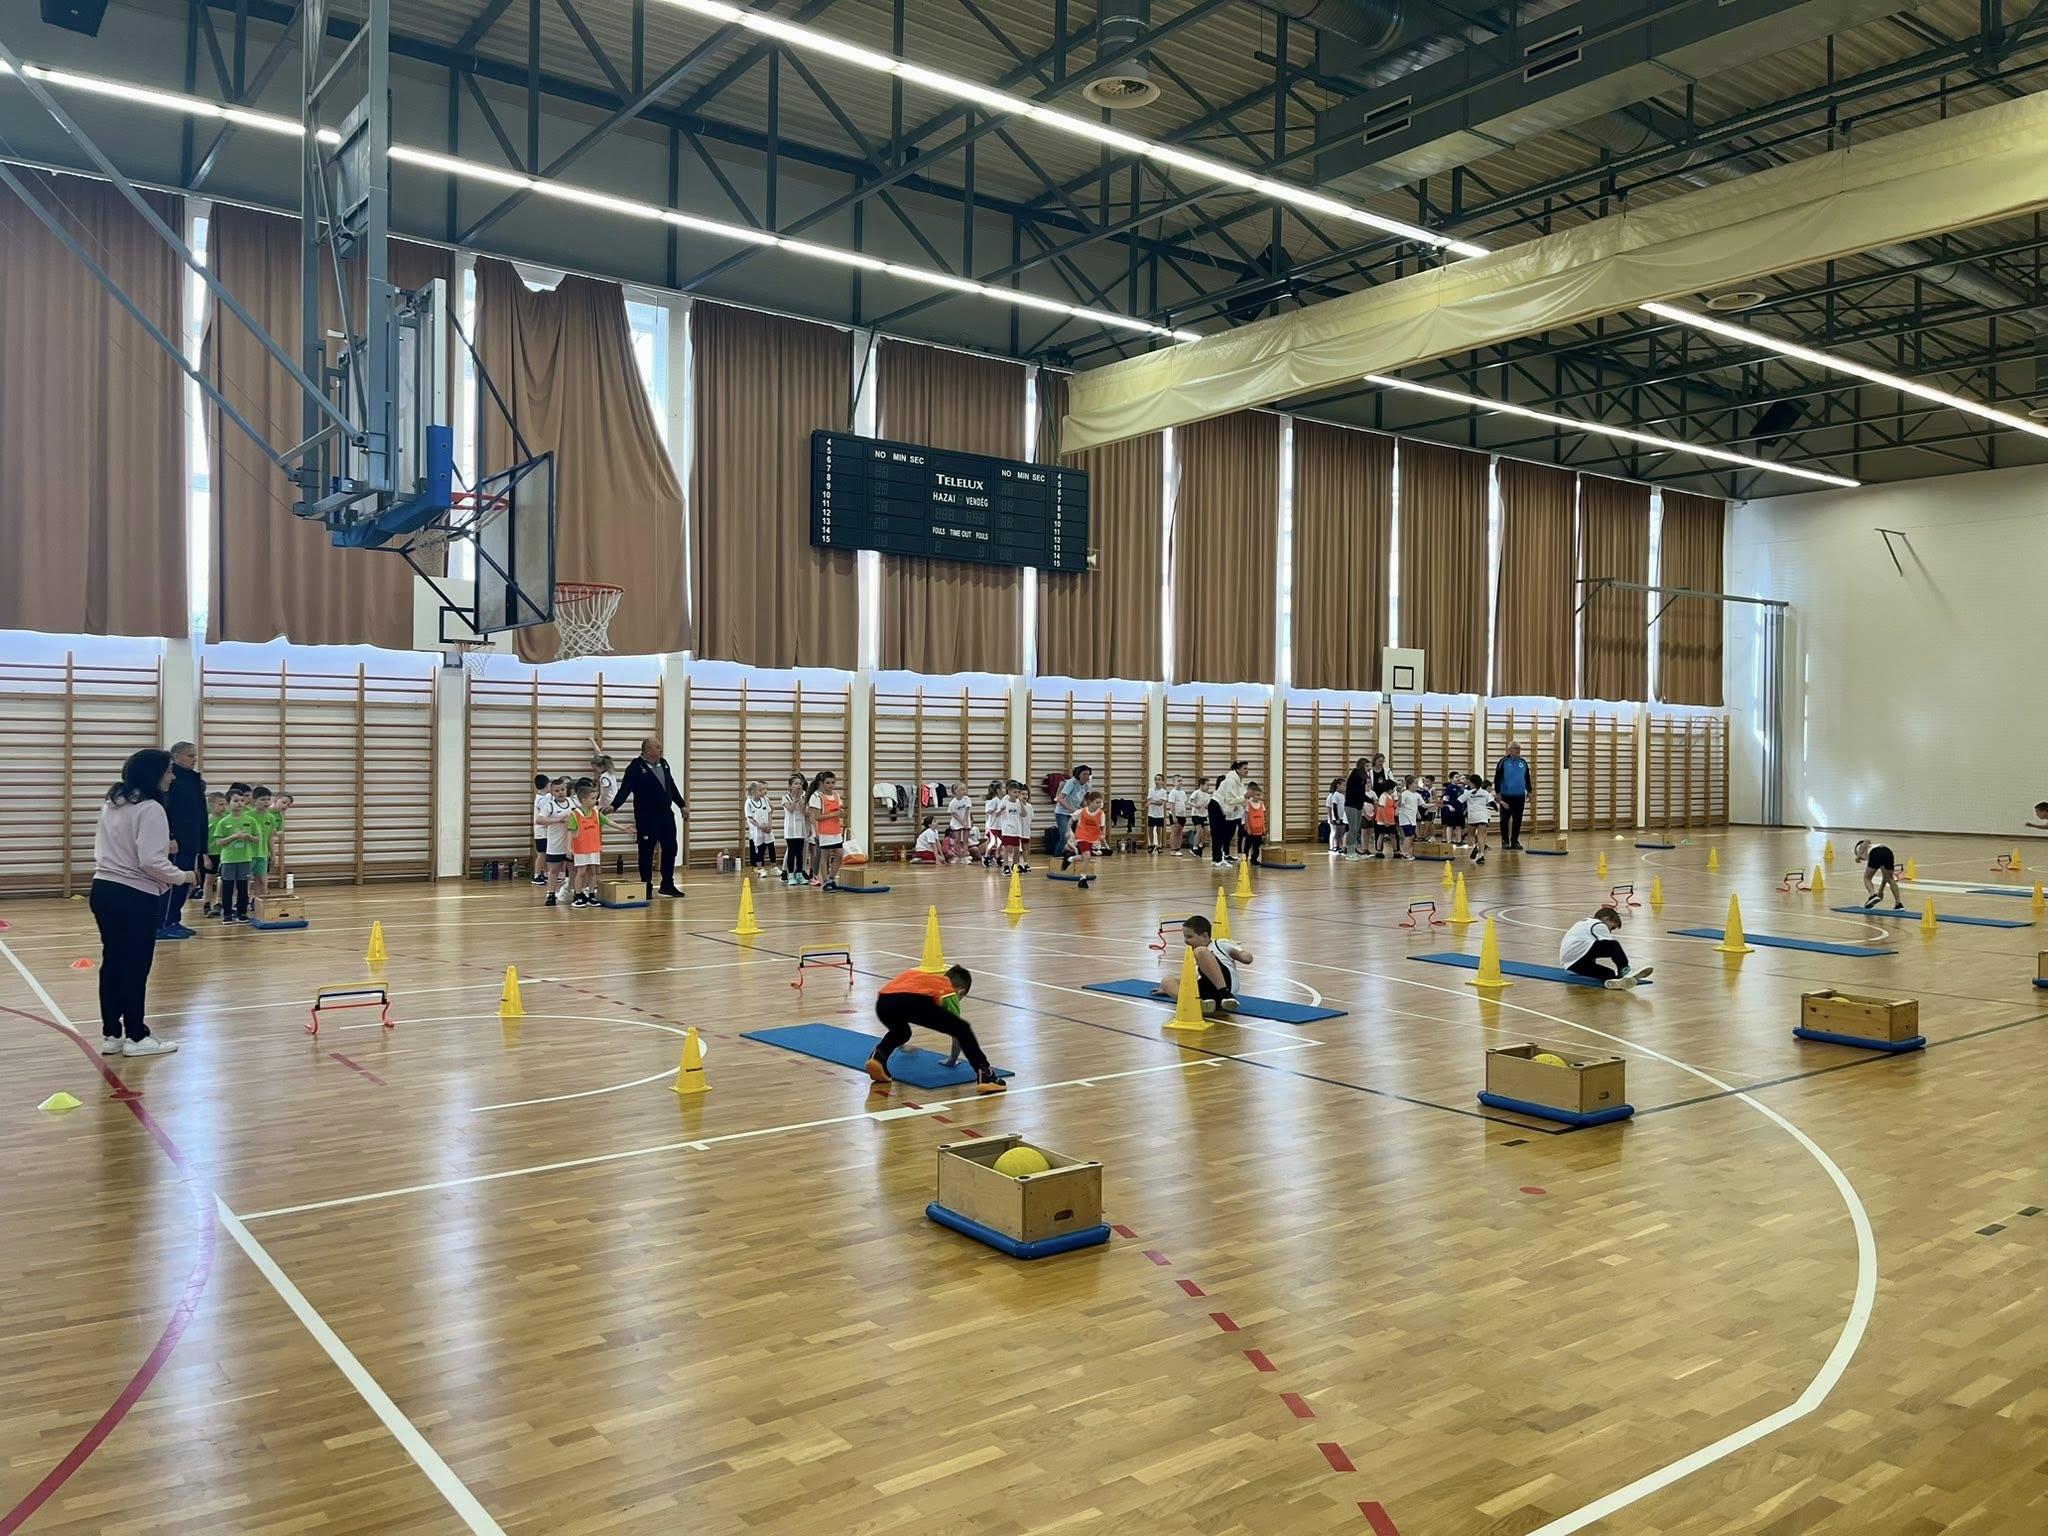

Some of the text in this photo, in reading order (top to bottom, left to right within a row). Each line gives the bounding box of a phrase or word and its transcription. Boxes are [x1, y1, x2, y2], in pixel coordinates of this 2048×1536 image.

[826, 438, 832, 446] 4
[874, 450, 925, 465] NO MIN SEC
[826, 464, 832, 472] 7
[826, 473, 832, 481] 8
[1001, 469, 1046, 482] NO MIN SEC
[826, 482, 832, 490] 9
[935, 473, 984, 491] TELELUX
[822, 491, 831, 499] 10
[932, 491, 956, 503] HAZAI
[965, 496, 989, 507] VENDÉG
[1057, 504, 1062, 512] 8
[822, 509, 831, 517] 12
[1057, 512, 1062, 520] 9
[822, 517, 831, 525] 13
[1054, 520, 1062, 528] 10
[821, 526, 831, 534] 14
[932, 526, 946, 535] FOULS
[949, 528, 972, 538] TIME OUT
[821, 535, 831, 543] 15
[975, 532, 989, 540] FOULS
[1053, 552, 1061, 560] 14
